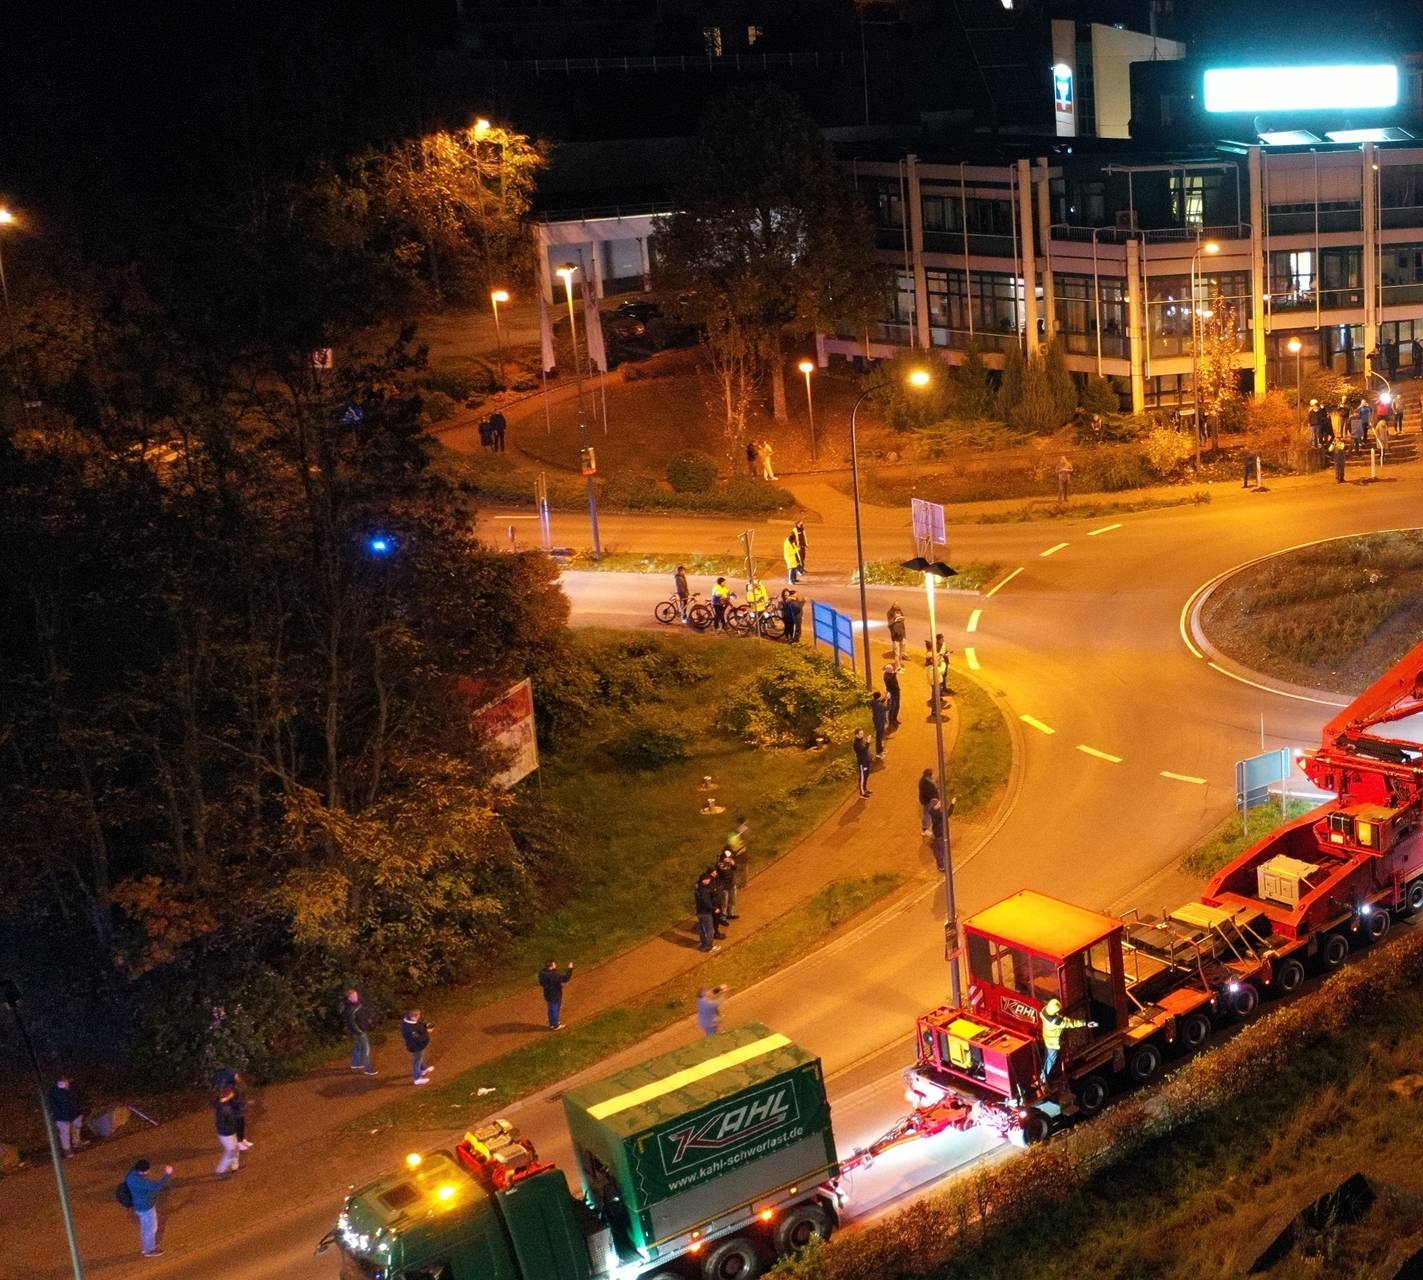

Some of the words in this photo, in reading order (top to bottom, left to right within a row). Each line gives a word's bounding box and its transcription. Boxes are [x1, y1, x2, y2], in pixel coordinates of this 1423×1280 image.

[1002, 997, 1036, 1023] KAHL
[668, 1126, 803, 1191] www.kahl-schwerlast.de
[669, 1090, 789, 1163] KAHL
